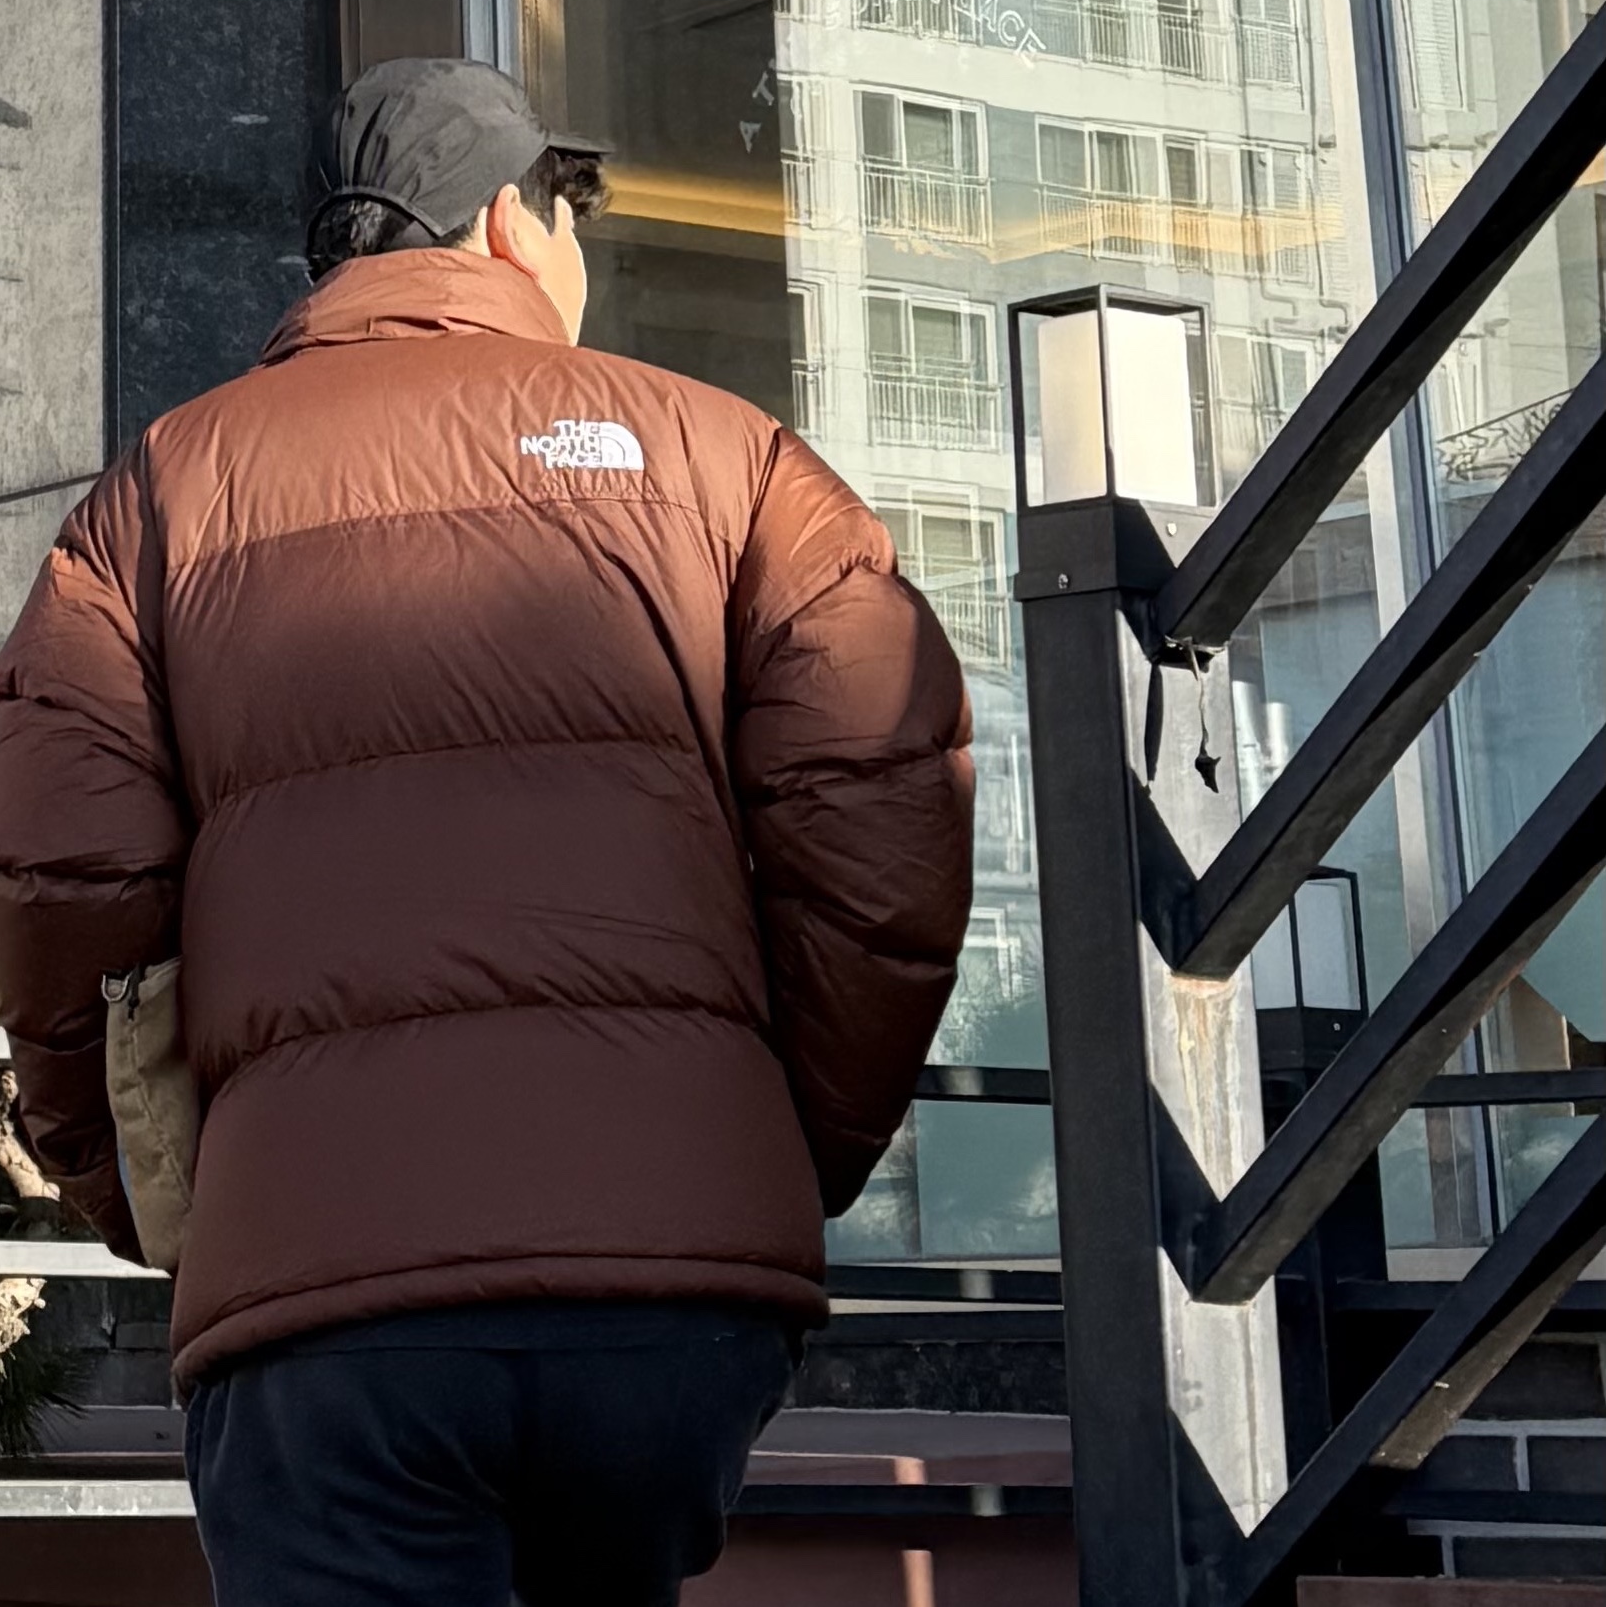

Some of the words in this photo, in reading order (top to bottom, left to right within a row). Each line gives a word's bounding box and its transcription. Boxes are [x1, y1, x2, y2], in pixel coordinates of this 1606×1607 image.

[552, 419, 601, 436] THE
[520, 435, 601, 456] NORTH
[545, 452, 603, 470] FACE
